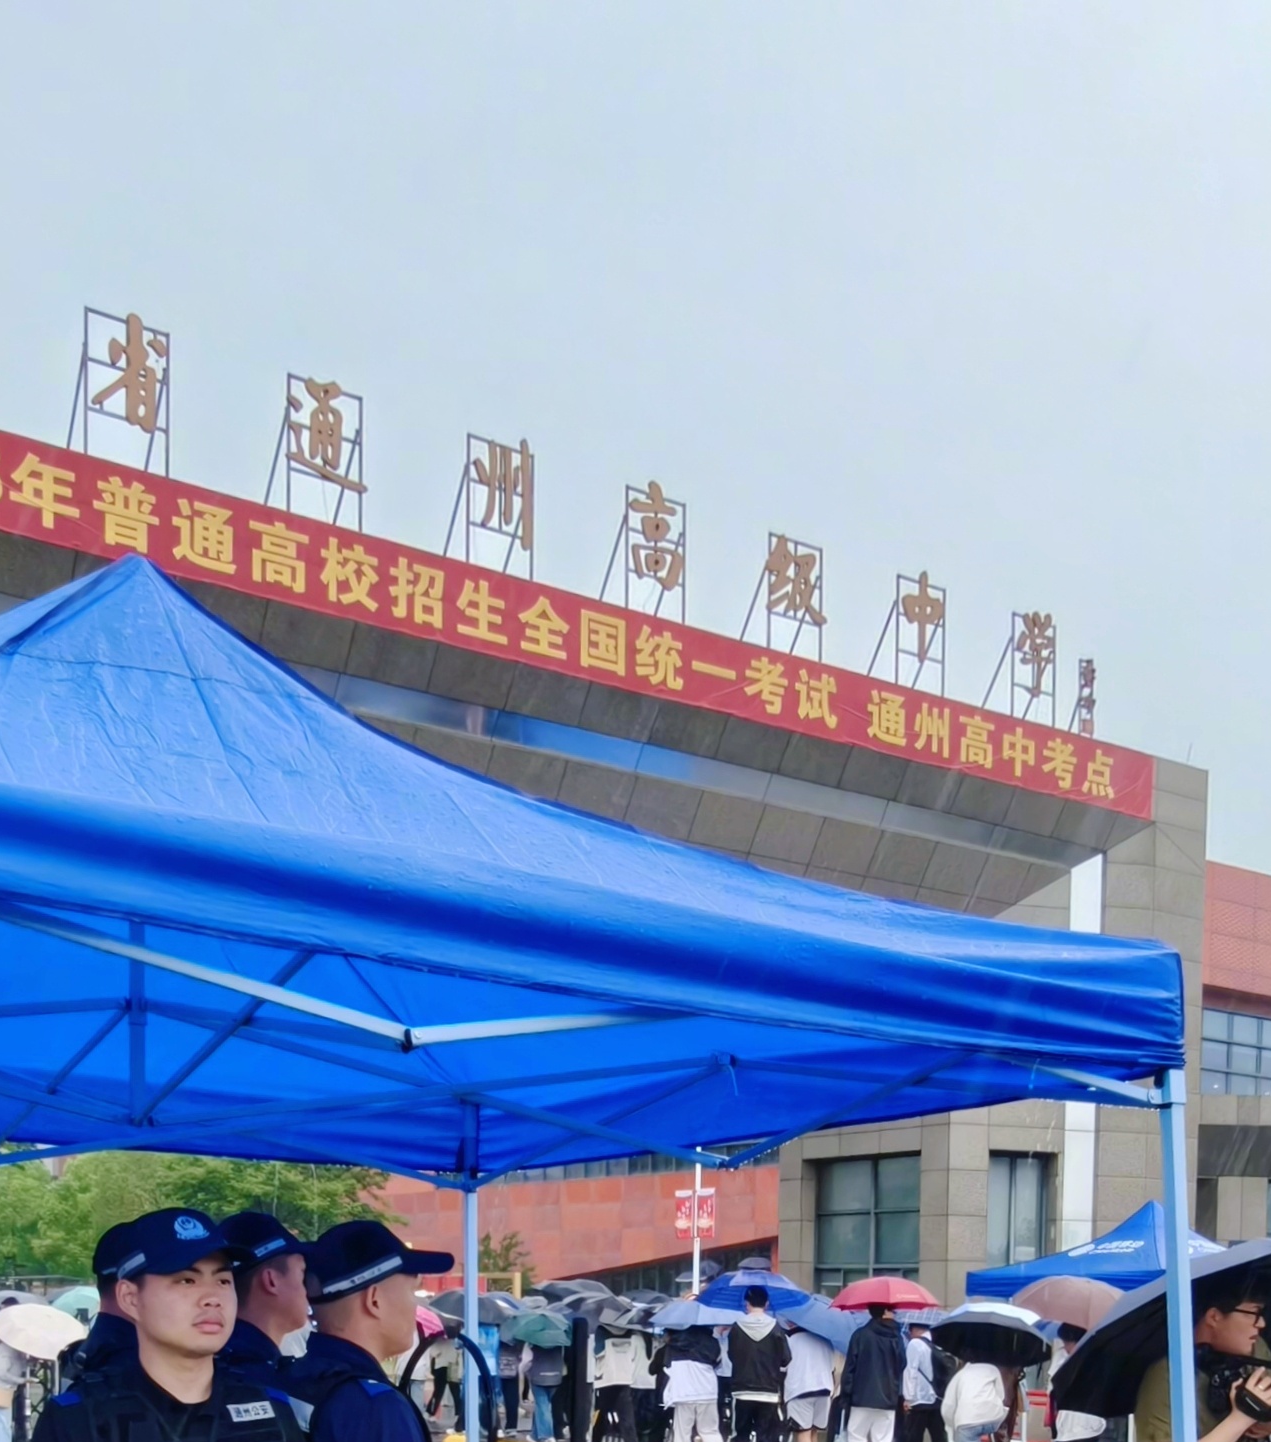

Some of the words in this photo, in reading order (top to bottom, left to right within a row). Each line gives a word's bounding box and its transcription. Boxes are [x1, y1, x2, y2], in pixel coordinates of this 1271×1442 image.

[866, 689, 1117, 800] 通州高中考点
